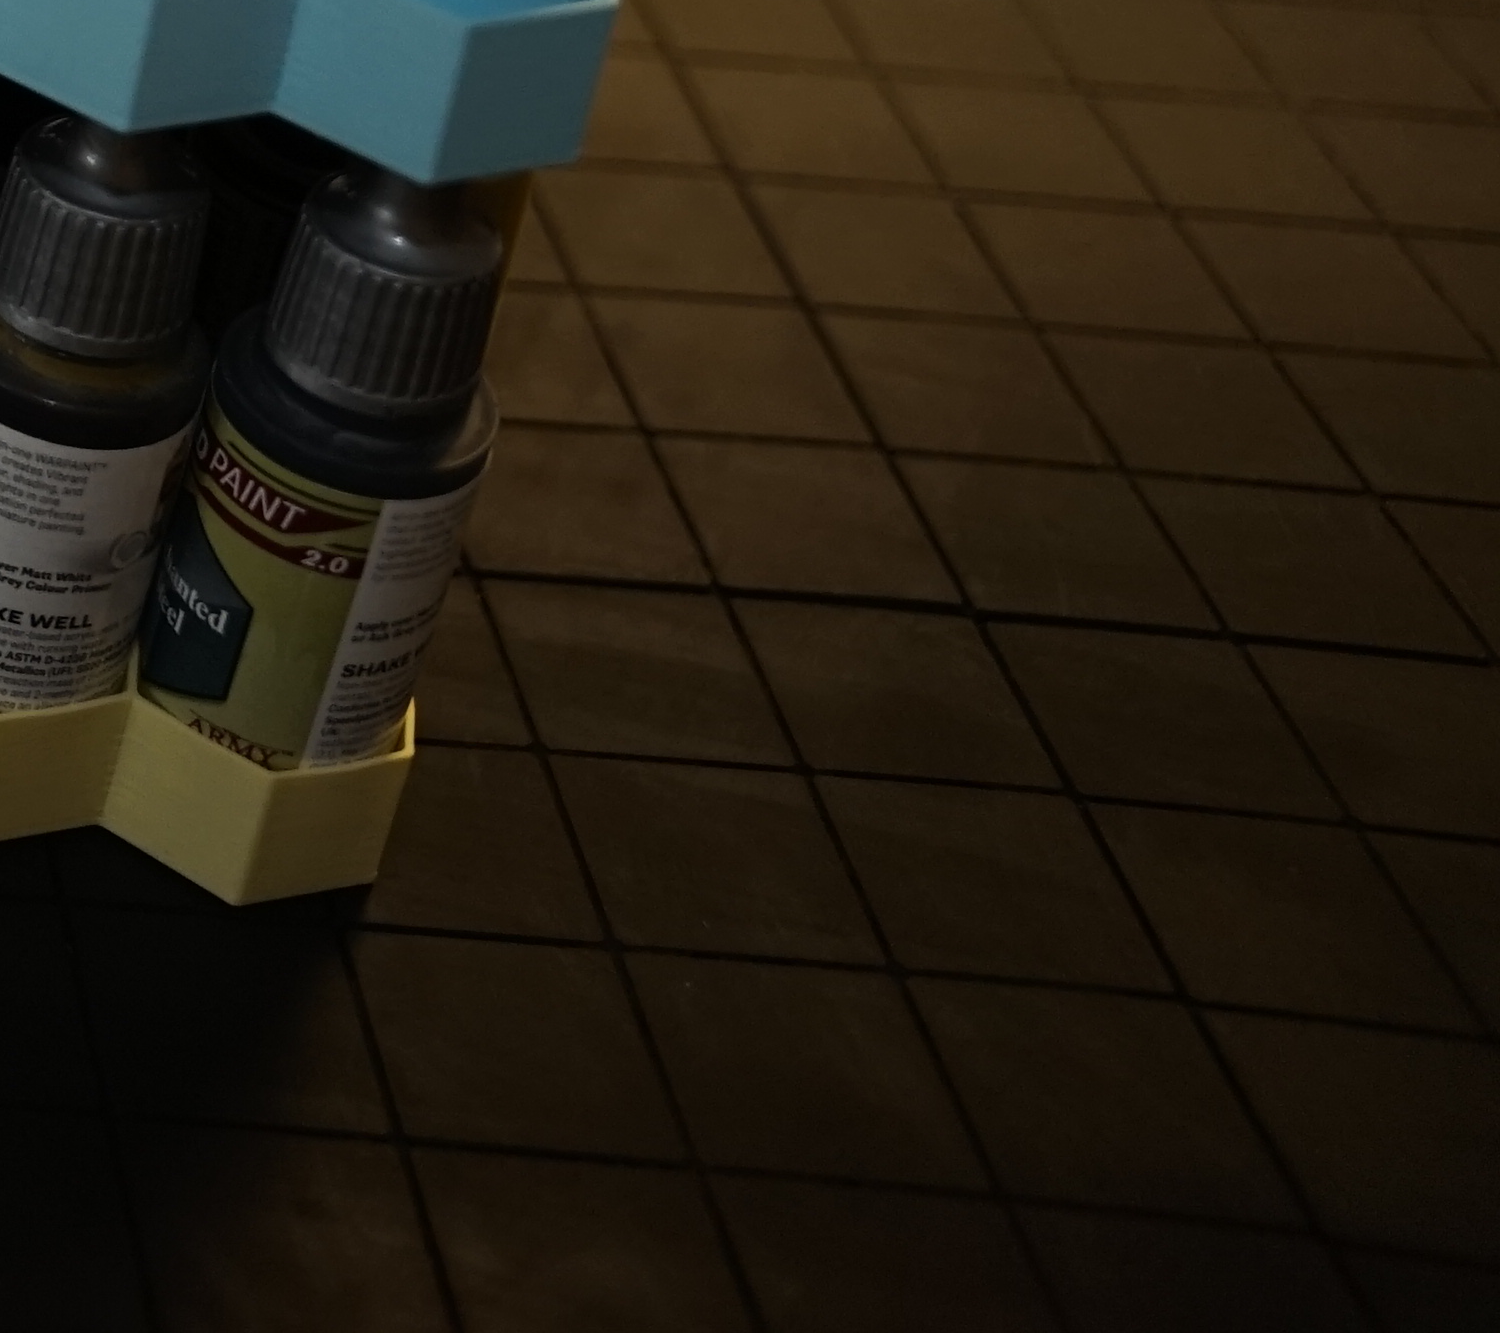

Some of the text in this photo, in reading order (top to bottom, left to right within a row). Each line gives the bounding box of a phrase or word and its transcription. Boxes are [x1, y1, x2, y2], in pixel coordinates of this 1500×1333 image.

[208, 451, 308, 532] PAINT
[300, 548, 350, 575] 2.0
[21, 567, 52, 581] Matt
[25, 579, 70, 594] Colour
[30, 614, 93, 630] WELL
[5, 651, 42, 664] ASTM
[341, 651, 412, 678] SHAKE
